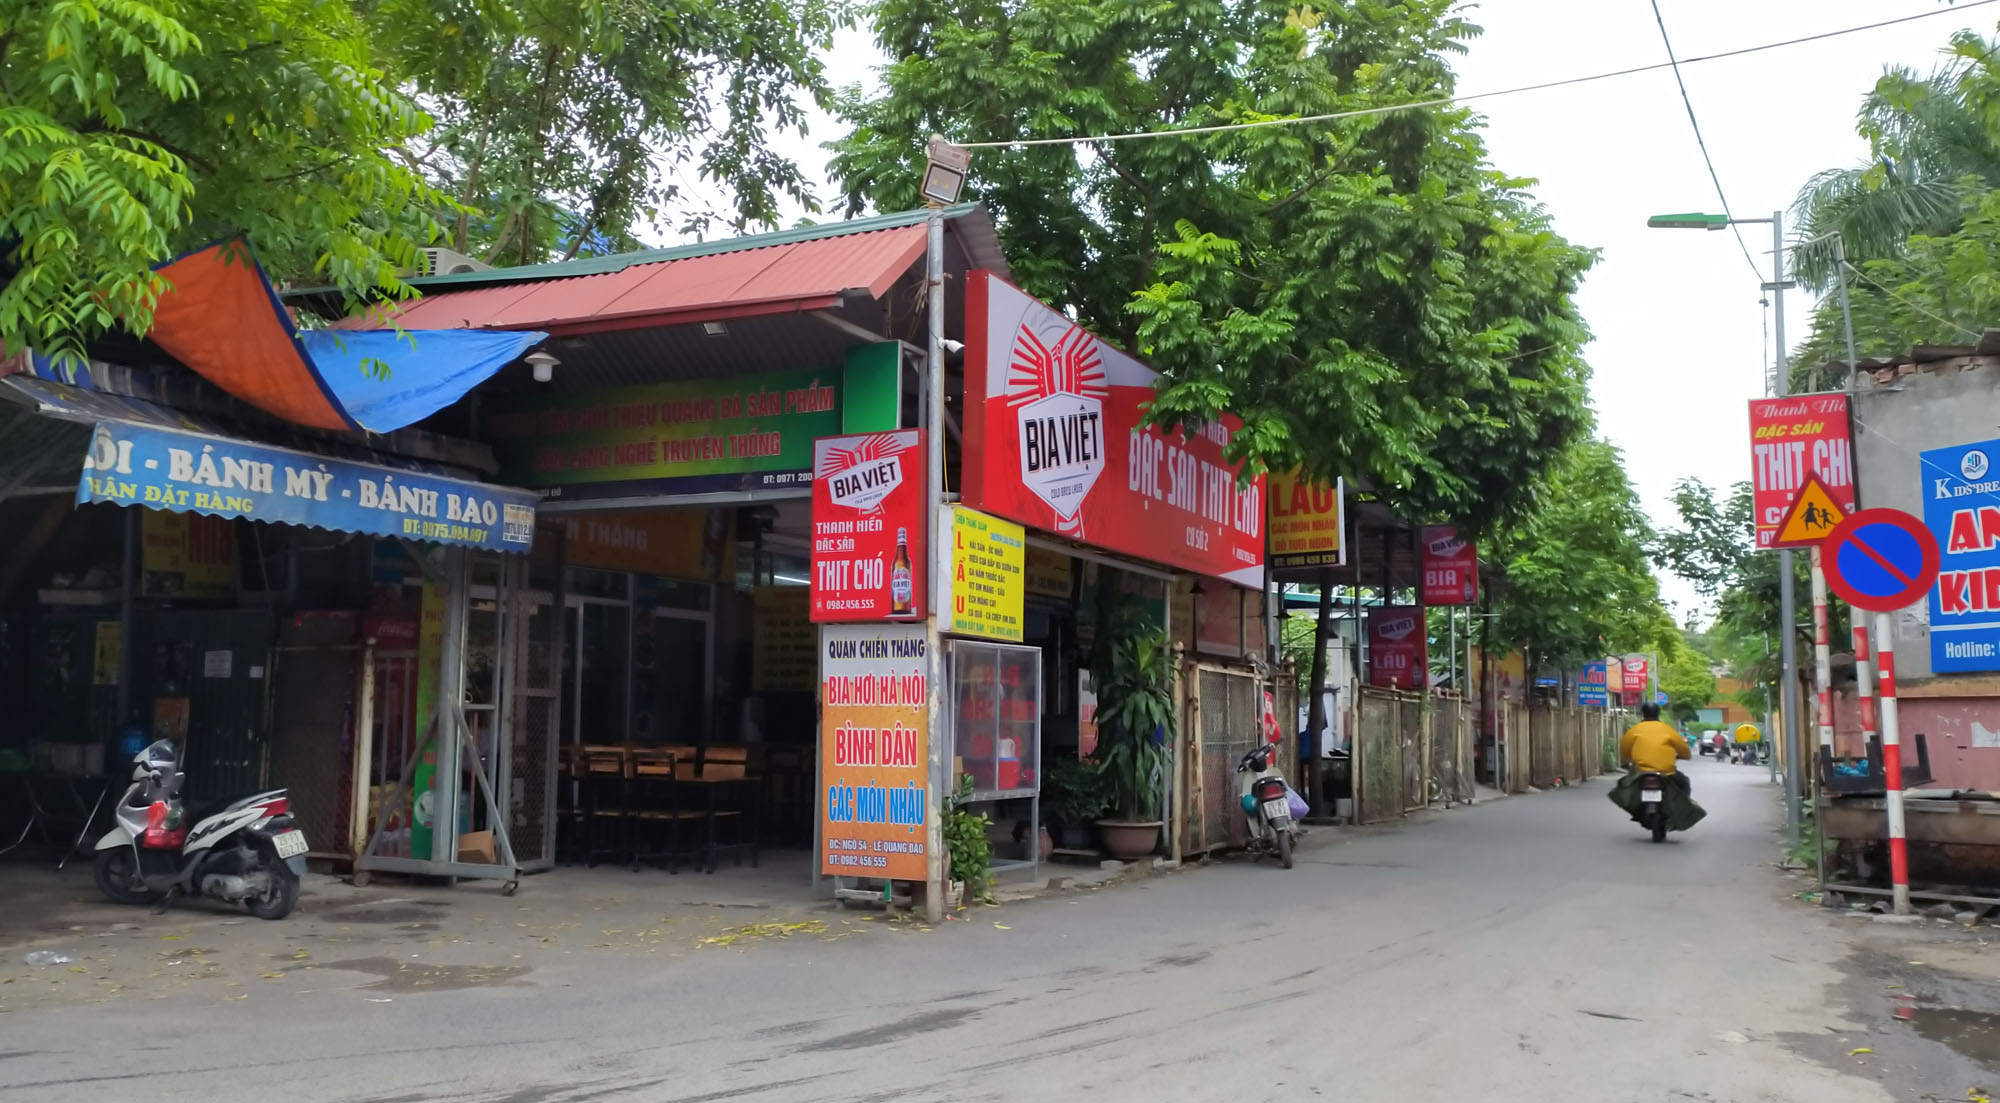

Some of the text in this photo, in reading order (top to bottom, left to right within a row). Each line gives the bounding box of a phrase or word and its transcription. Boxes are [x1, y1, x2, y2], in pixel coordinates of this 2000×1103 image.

[728, 424, 781, 459] THỐNG
[1024, 404, 1098, 472] BIA VIỆT
[168, 444, 274, 494] BÁNH
[359, 475, 439, 518] BÁNH
[446, 493, 498, 526] BAO
[776, 473, 795, 483] 0971
[833, 461, 895, 498] BIA VIỆT
[1129, 422, 1163, 510] ĐẶC
[1168, 434, 1197, 513] SẢN
[1201, 460, 1231, 536] THỊT
[1754, 441, 1805, 501] THỊT
[144, 484, 190, 509] ĐẶT
[194, 490, 253, 513] HÀNG
[816, 521, 853, 535] THANH
[817, 551, 884, 597] THỊT CHÓ
[1426, 569, 1456, 586] BIA
[860, 633, 888, 659] CHIẾN
[1945, 641, 1995, 659] Hotline:
[829, 675, 850, 705] BIA
[854, 672, 875, 705] HƠI
[880, 669, 897, 705] HÀ
[902, 669, 924, 712] NỘI
[835, 722, 917, 766] BÌNH DÂN
[828, 779, 925, 833] CÁC MÓN NHẬU
[884, 841, 907, 854] QUANG
